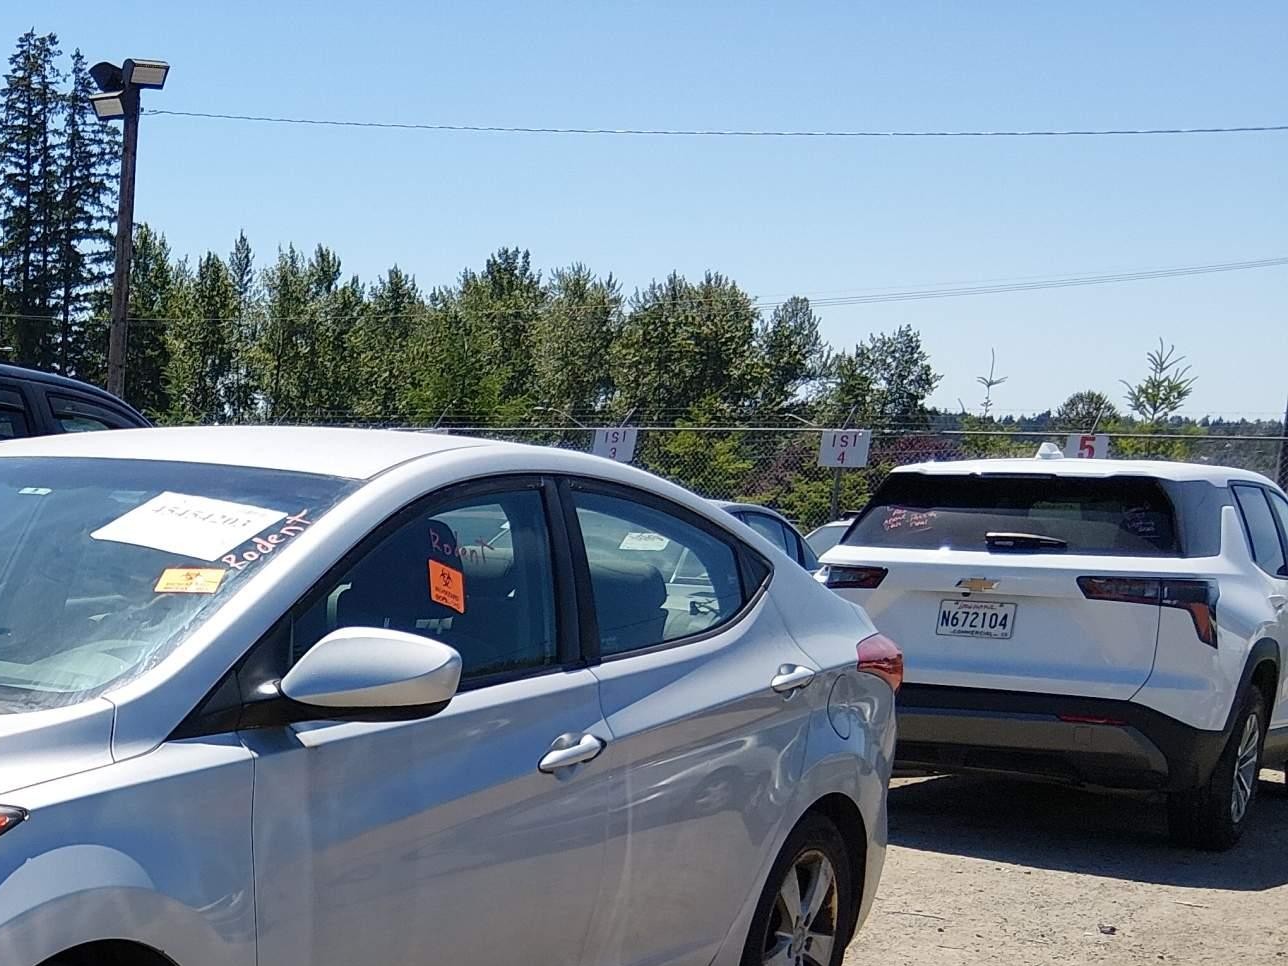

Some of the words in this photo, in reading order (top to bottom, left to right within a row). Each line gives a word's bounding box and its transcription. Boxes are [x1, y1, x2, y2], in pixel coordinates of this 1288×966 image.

[609, 447, 617, 458] 3
[837, 451, 845, 464] 4
[1078, 435, 1096, 459] 5
[221, 509, 312, 570] Rodent
[429, 527, 495, 565] Rodent
[940, 610, 1009, 630] N672104
